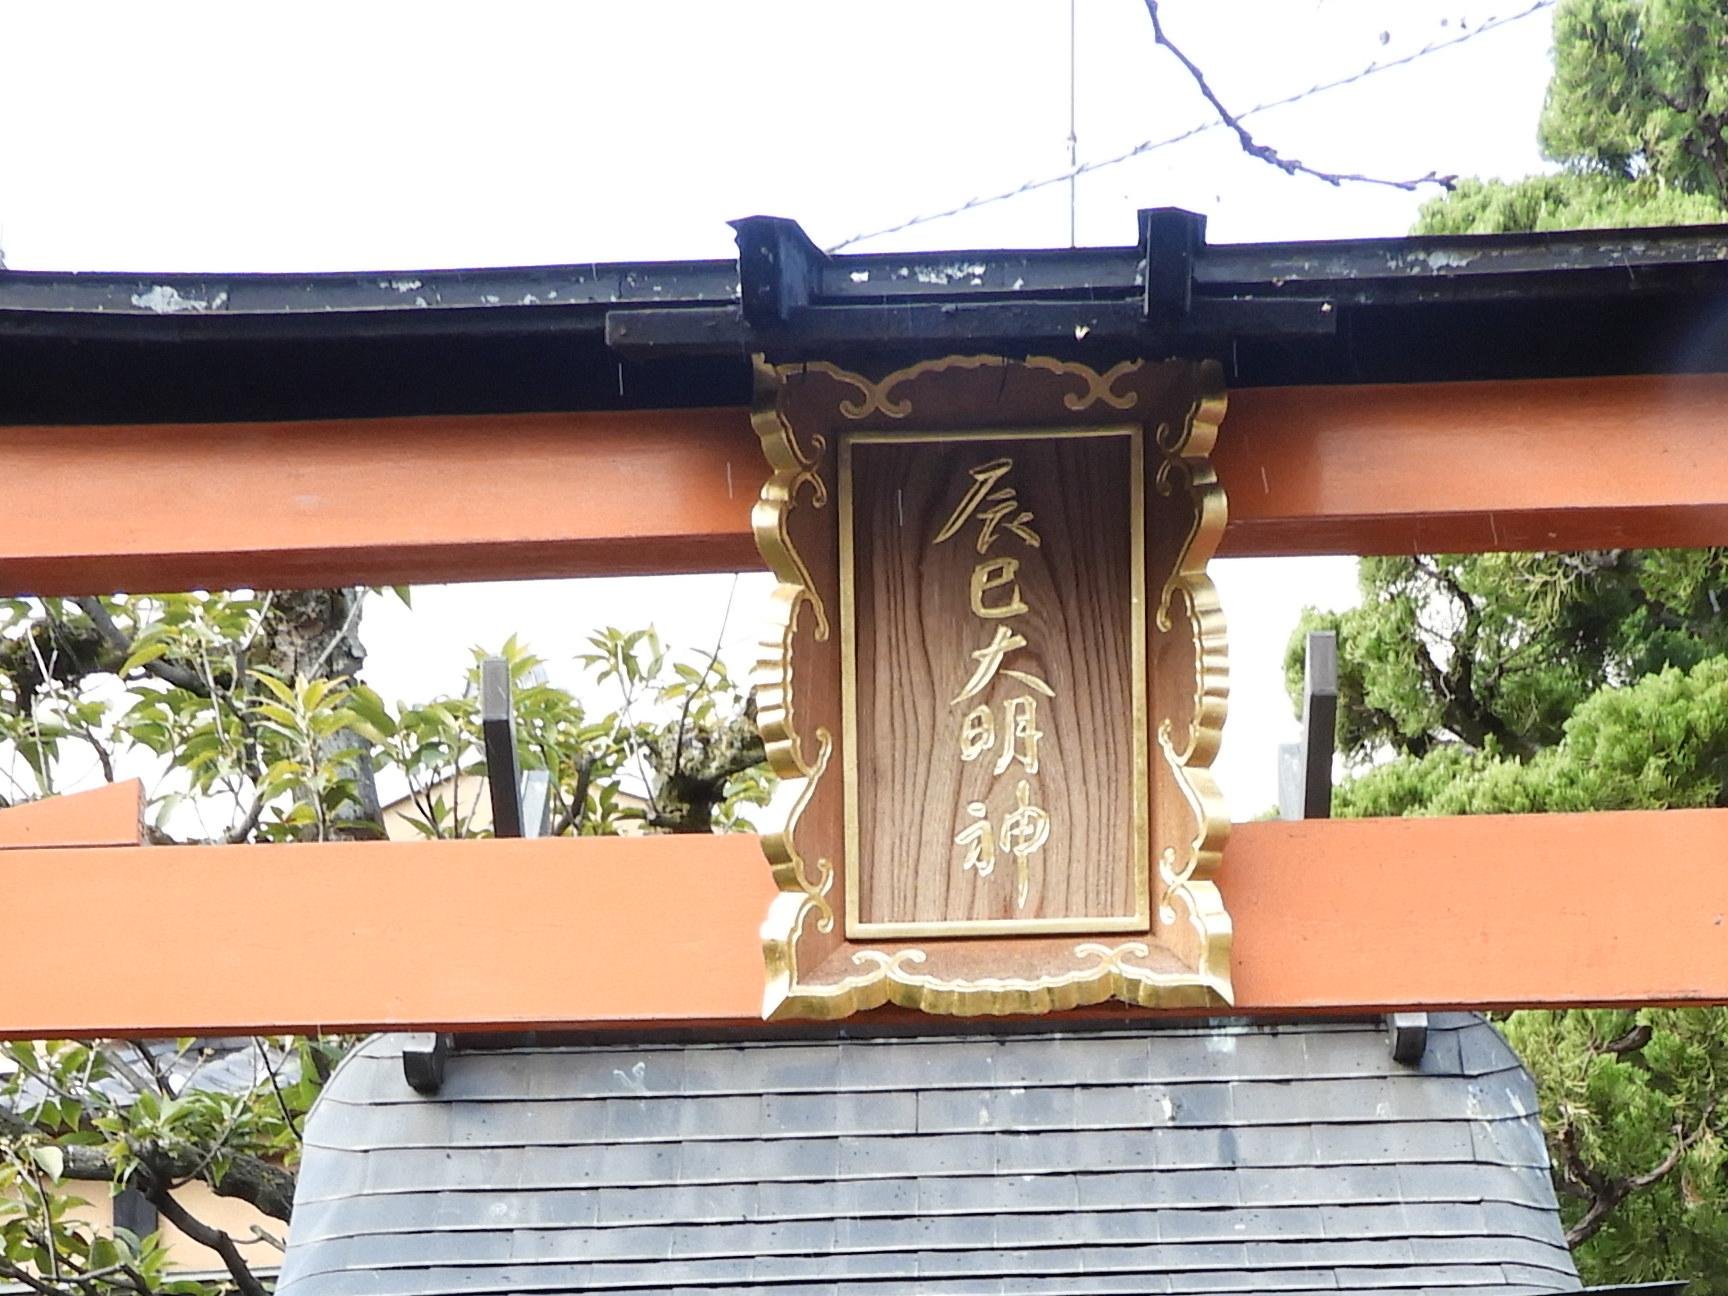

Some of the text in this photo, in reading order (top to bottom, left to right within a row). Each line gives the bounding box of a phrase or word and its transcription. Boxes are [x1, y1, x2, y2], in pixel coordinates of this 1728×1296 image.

[932, 457, 1056, 909] 辰巳大明神
